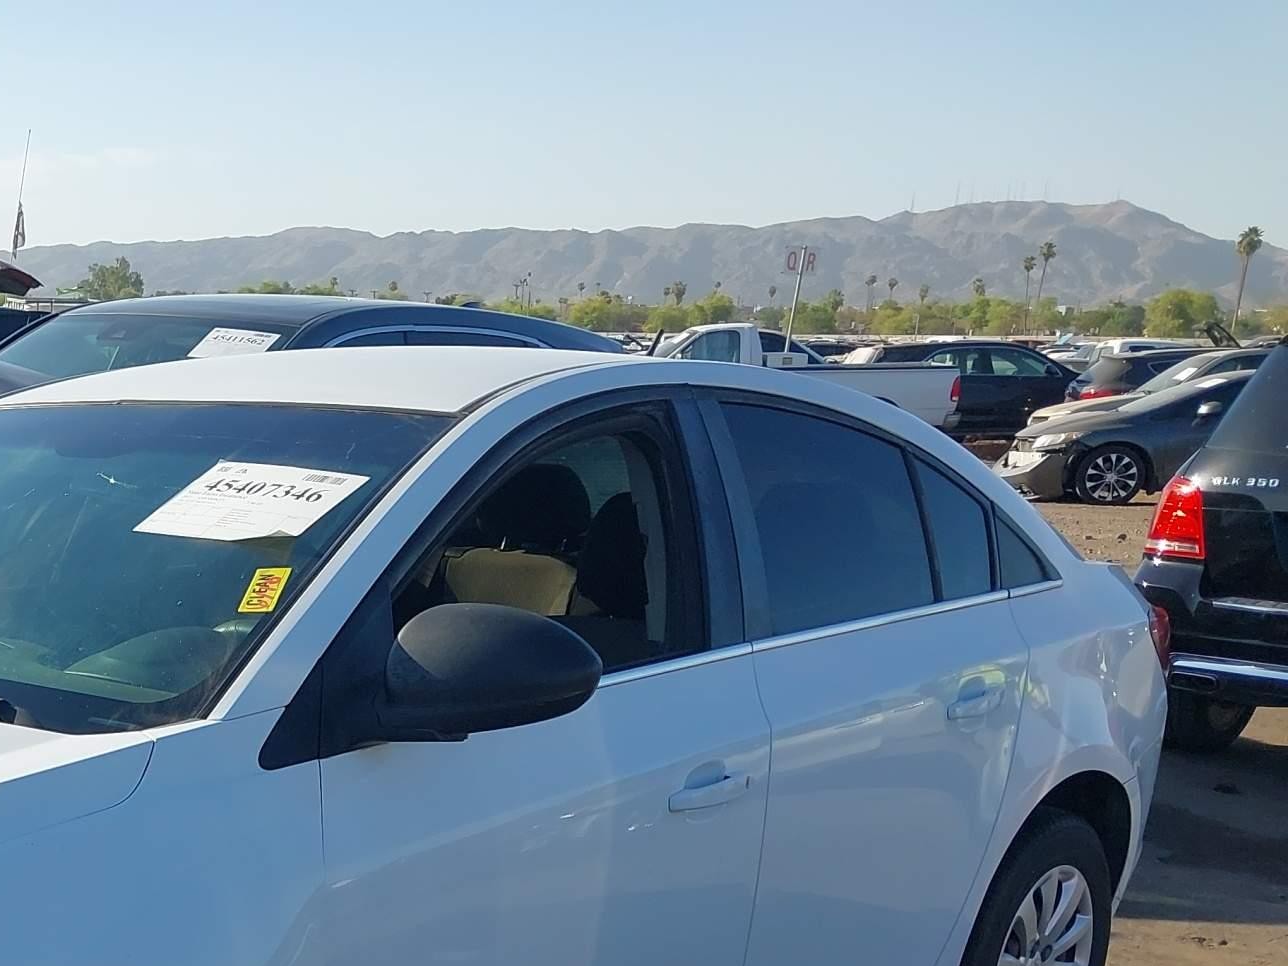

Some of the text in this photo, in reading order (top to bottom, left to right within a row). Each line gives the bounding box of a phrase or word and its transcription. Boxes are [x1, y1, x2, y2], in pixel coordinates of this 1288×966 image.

[205, 478, 329, 503] 45407346
[1246, 477, 1280, 487] 350
[246, 574, 275, 606] CLEAN
